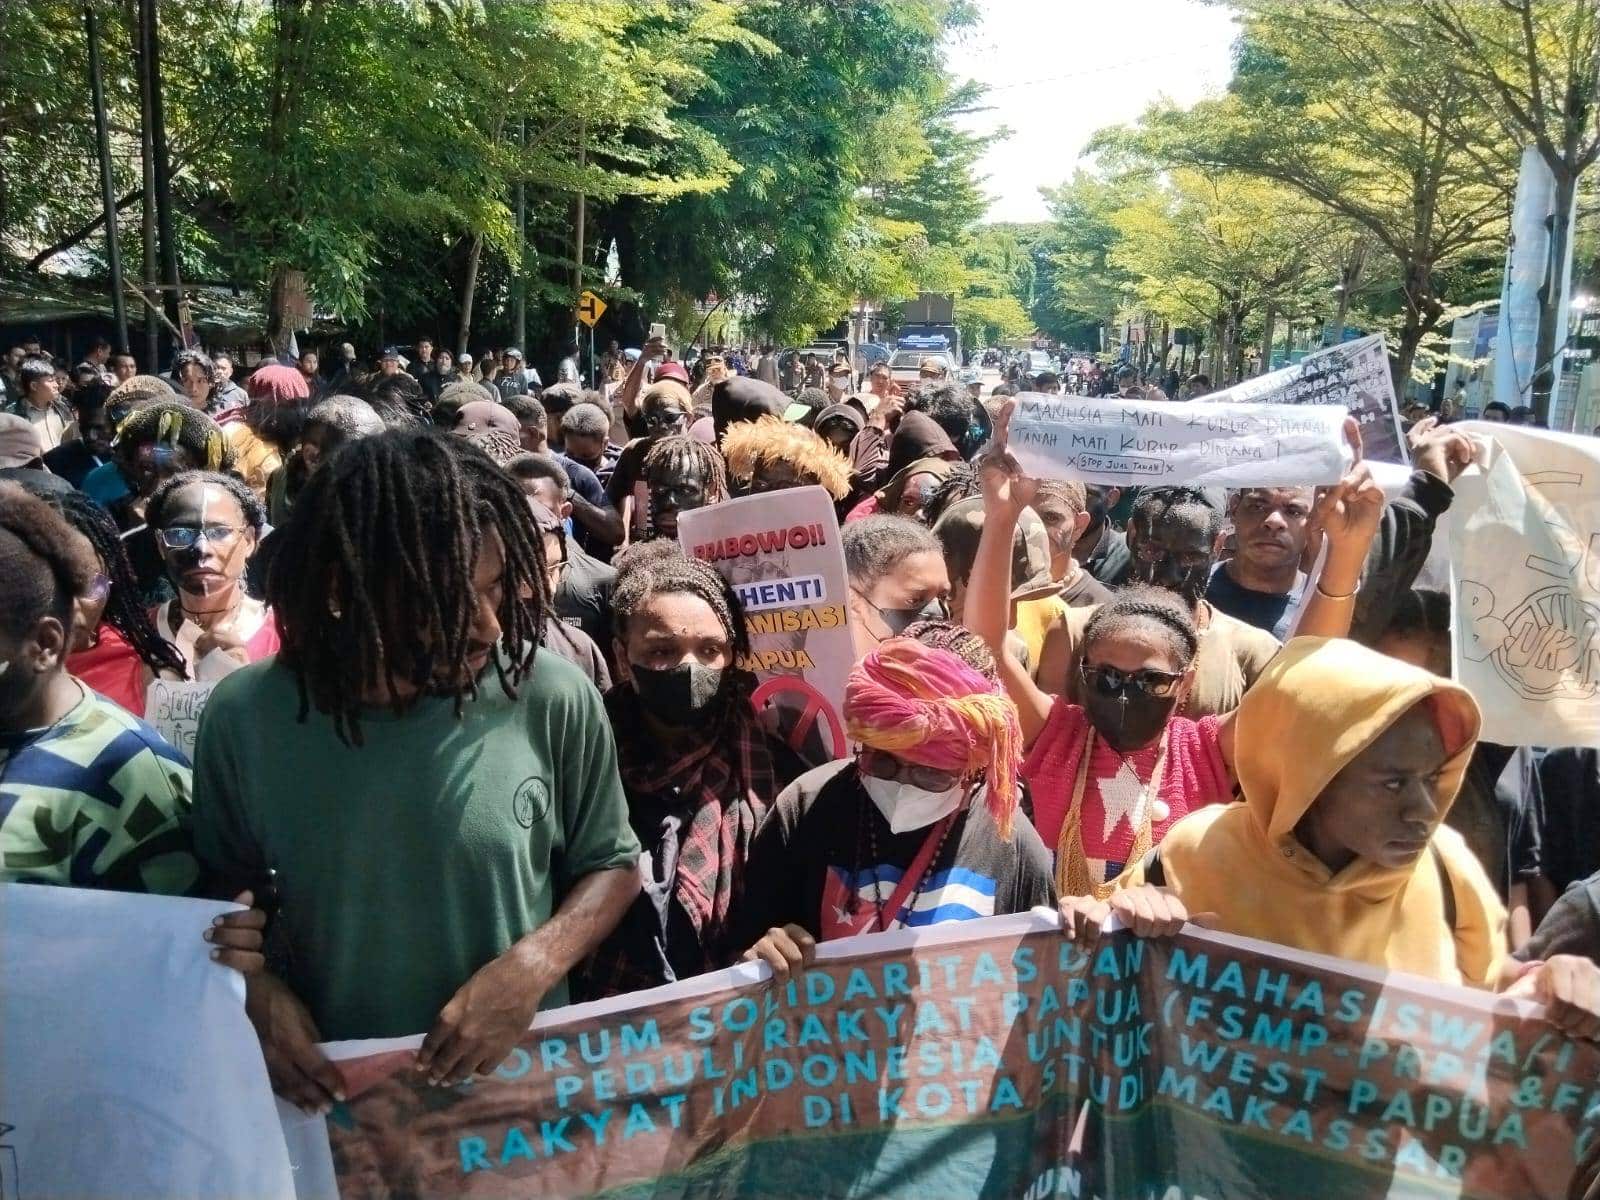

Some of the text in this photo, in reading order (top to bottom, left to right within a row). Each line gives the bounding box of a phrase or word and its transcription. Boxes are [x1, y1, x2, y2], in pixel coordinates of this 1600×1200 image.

[1014, 427, 1058, 447] TANAH
[1071, 434, 1107, 448] MATI
[1019, 402, 1103, 424] MANUSIA
[1121, 408, 1163, 427] MATI
[1081, 456, 1102, 468] STOP
[1105, 460, 1129, 470] JUAL
[1133, 462, 1159, 472] TANAH
[494, 1018, 662, 1080] ORUM
[1058, 939, 1144, 981] DAN
[555, 1038, 744, 1109] PEDULI
[764, 996, 977, 1051] RAKYAT
[1003, 978, 1141, 1026] PAPUA
[458, 1094, 687, 1173] RAKYAT
[713, 1036, 1004, 1117] INDONESIA
[1027, 1017, 1154, 1068] UNTUK
[1180, 1033, 1328, 1102] WEST
[1348, 1078, 1527, 1151] PAPUA
[803, 1052, 1467, 1176] DI KOTA STUDI MAKASSAR
